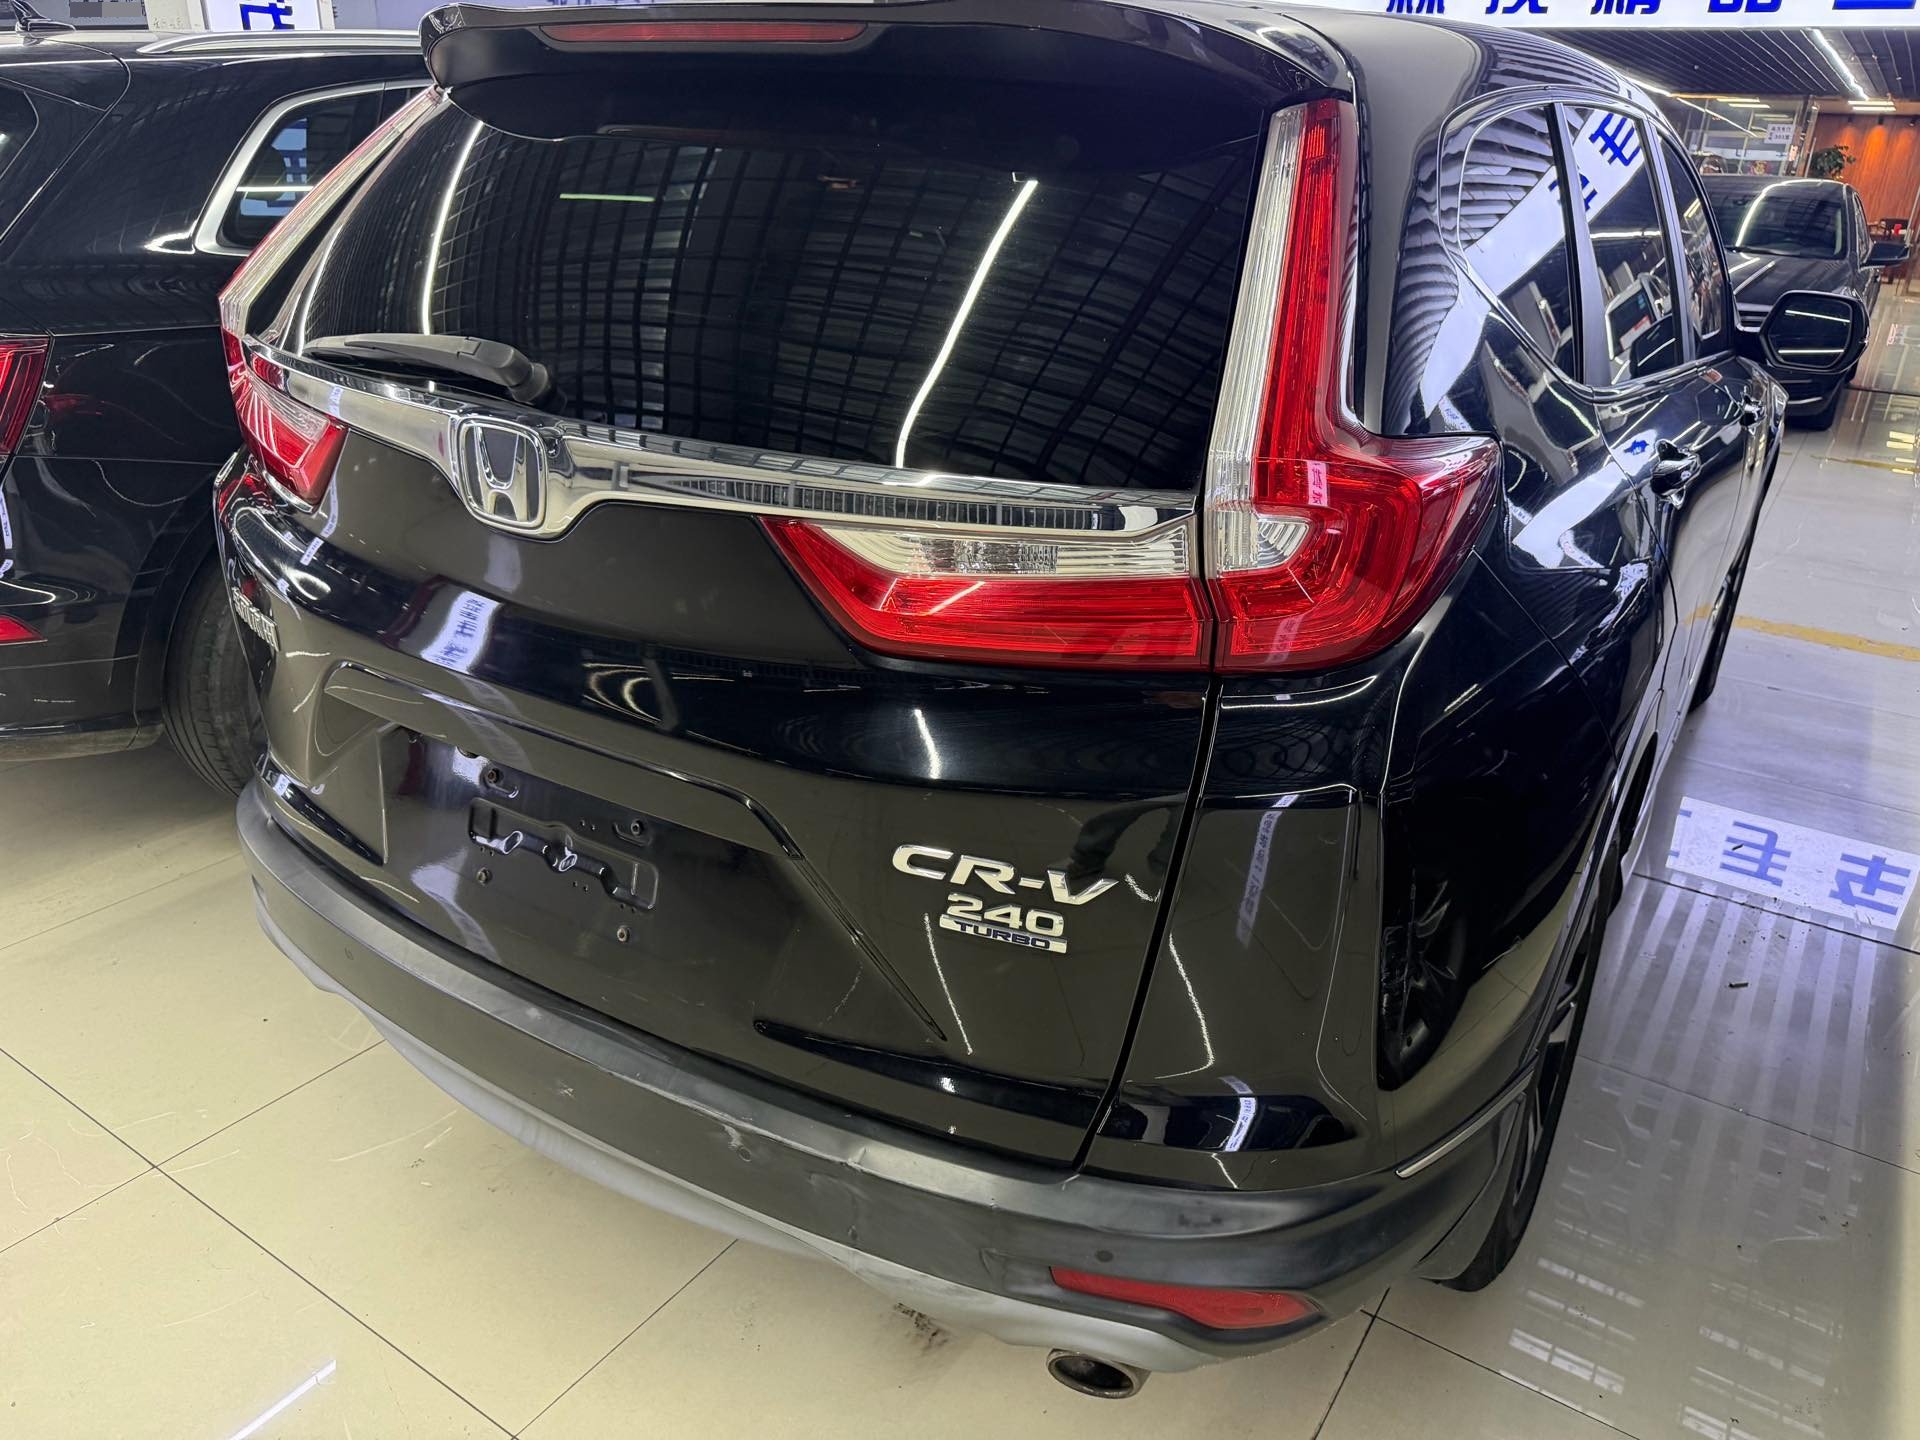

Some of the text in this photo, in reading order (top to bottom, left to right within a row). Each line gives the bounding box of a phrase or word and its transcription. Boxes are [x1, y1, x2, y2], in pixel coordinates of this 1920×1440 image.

[892, 844, 1119, 906] CR-V
[947, 893, 1065, 937] 240
[955, 920, 1051, 949] TURBO
